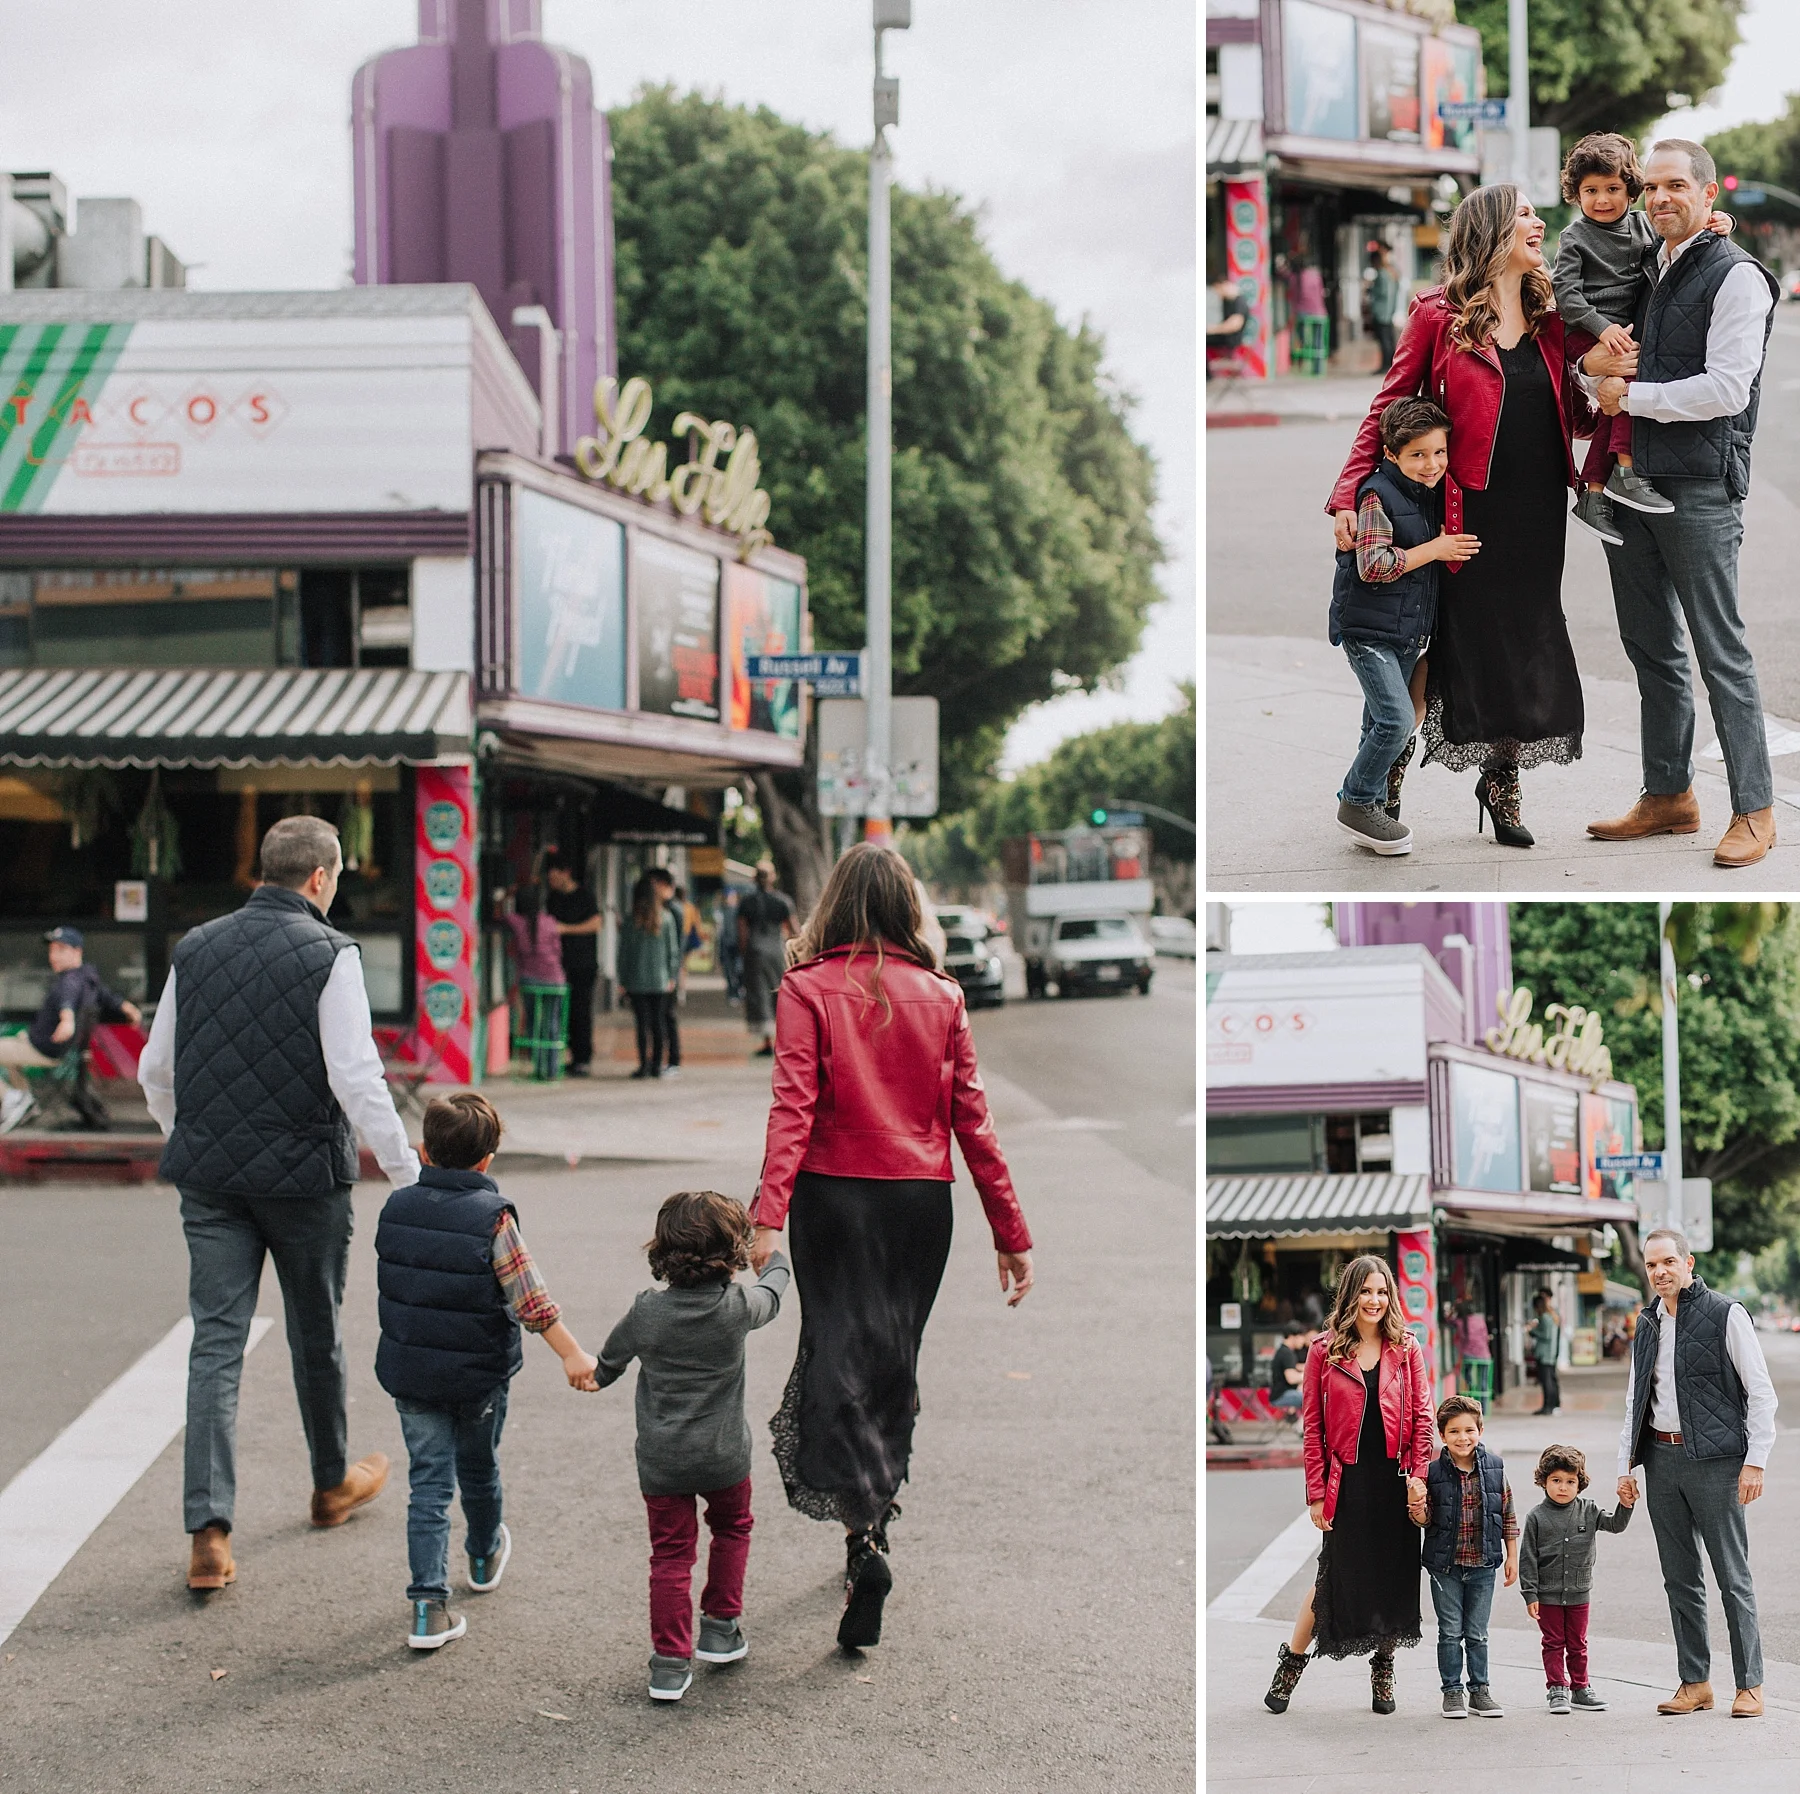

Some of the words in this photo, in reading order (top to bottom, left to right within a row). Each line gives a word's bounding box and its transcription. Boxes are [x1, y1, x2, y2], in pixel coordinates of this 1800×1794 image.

[10, 395, 270, 427] TACOS
[758, 656, 822, 676] Russell
[825, 656, 849, 675] Av
